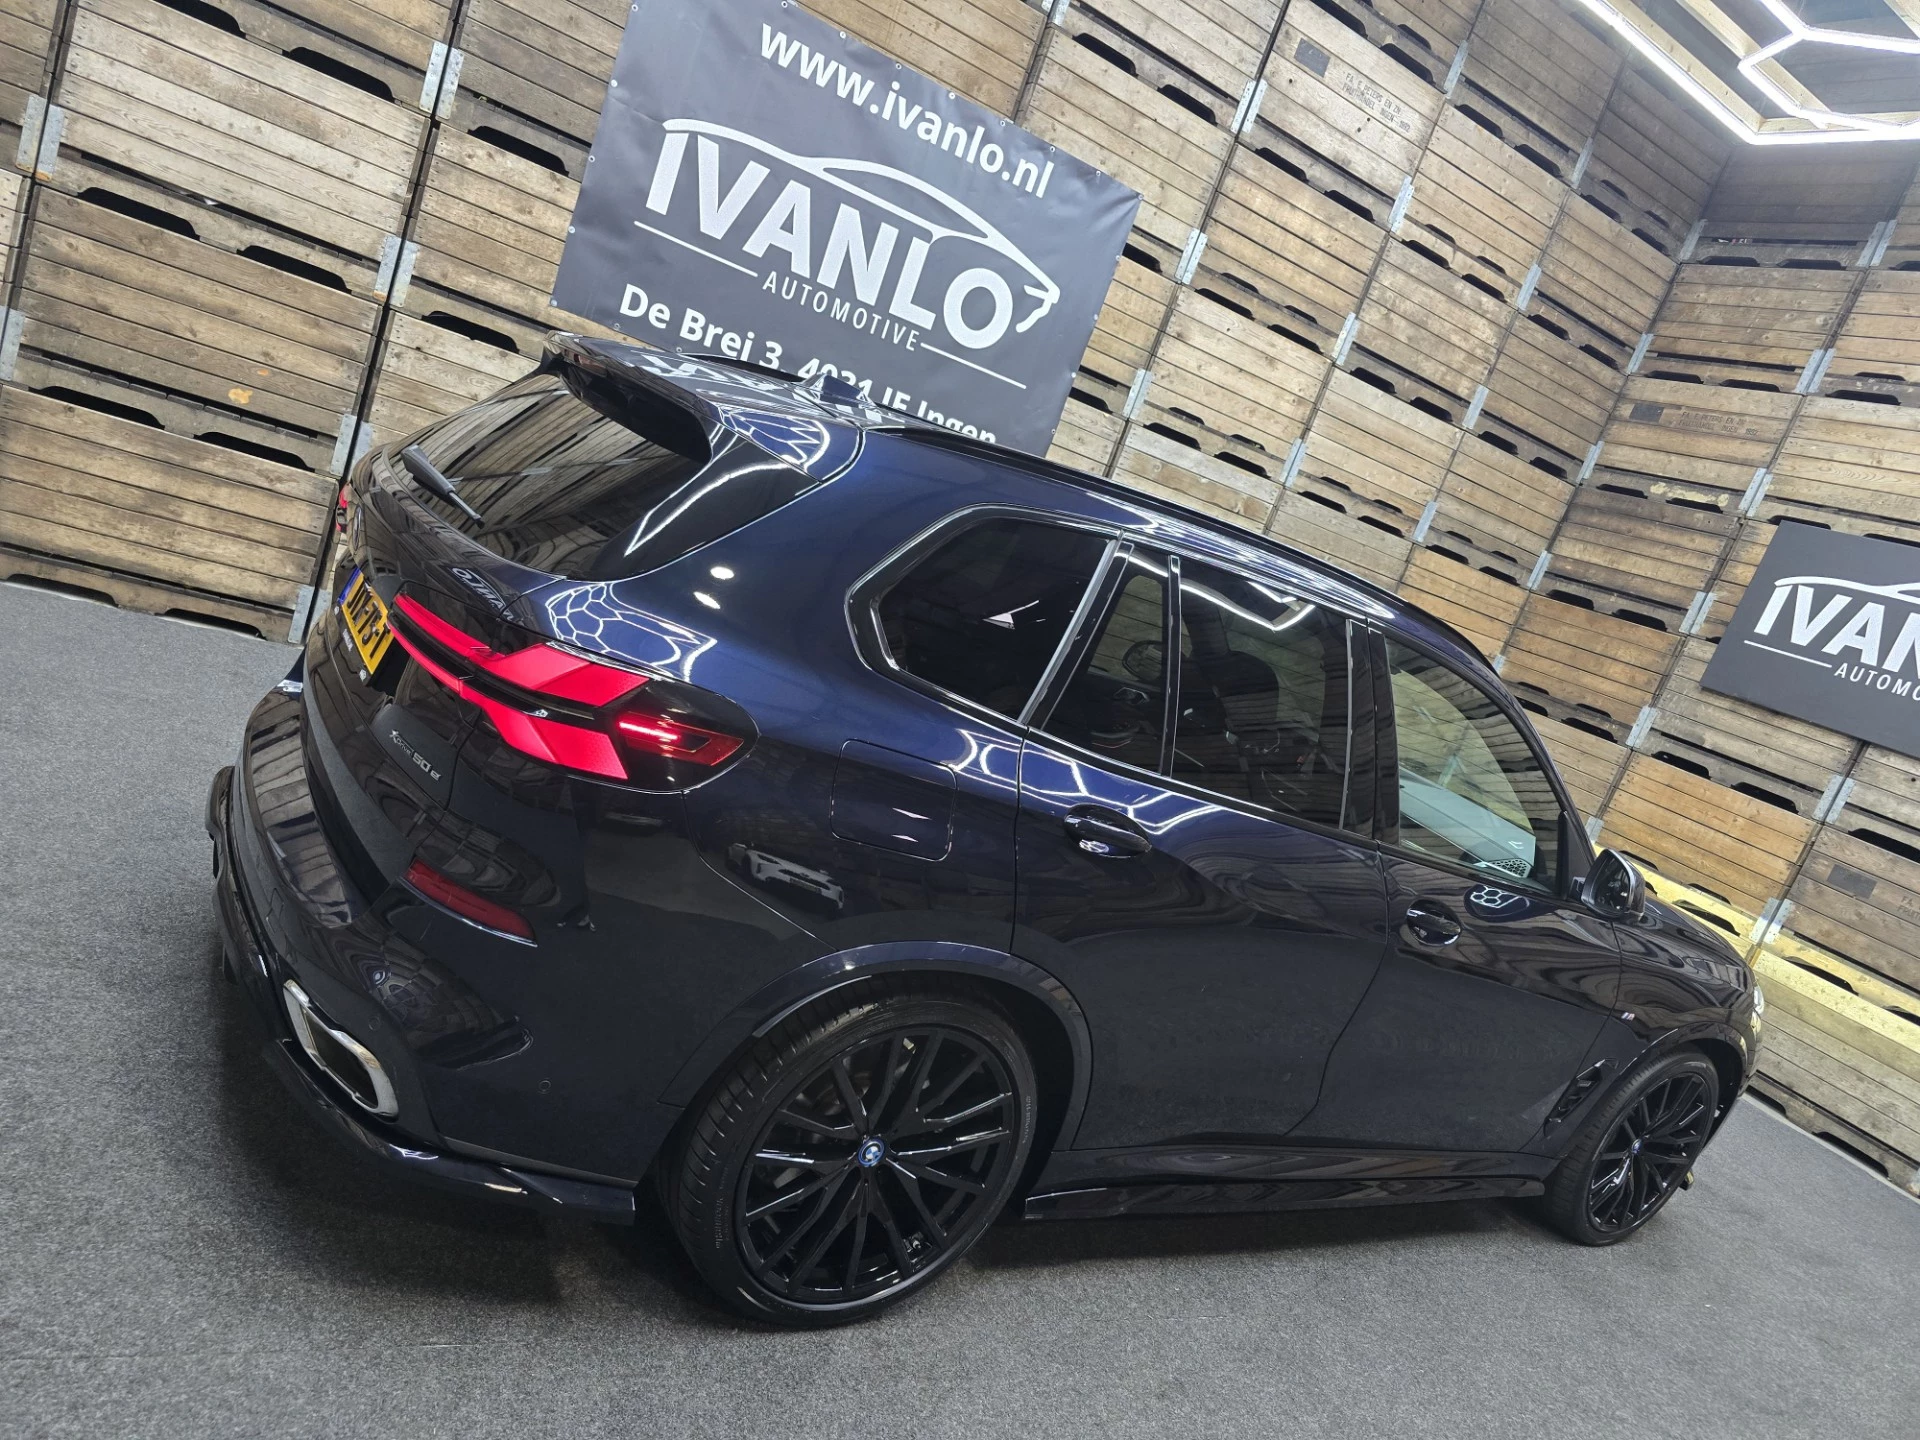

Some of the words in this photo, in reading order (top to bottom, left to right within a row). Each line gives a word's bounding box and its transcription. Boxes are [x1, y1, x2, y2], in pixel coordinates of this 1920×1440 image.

[761, 22, 1055, 198] www.ivanlo.nl
[645, 132, 1013, 350] IVANLO
[619, 283, 672, 330] De
[679, 307, 755, 362] Brei
[758, 341, 787, 371] 3
[762, 271, 920, 351] AUTOMOTIVE
